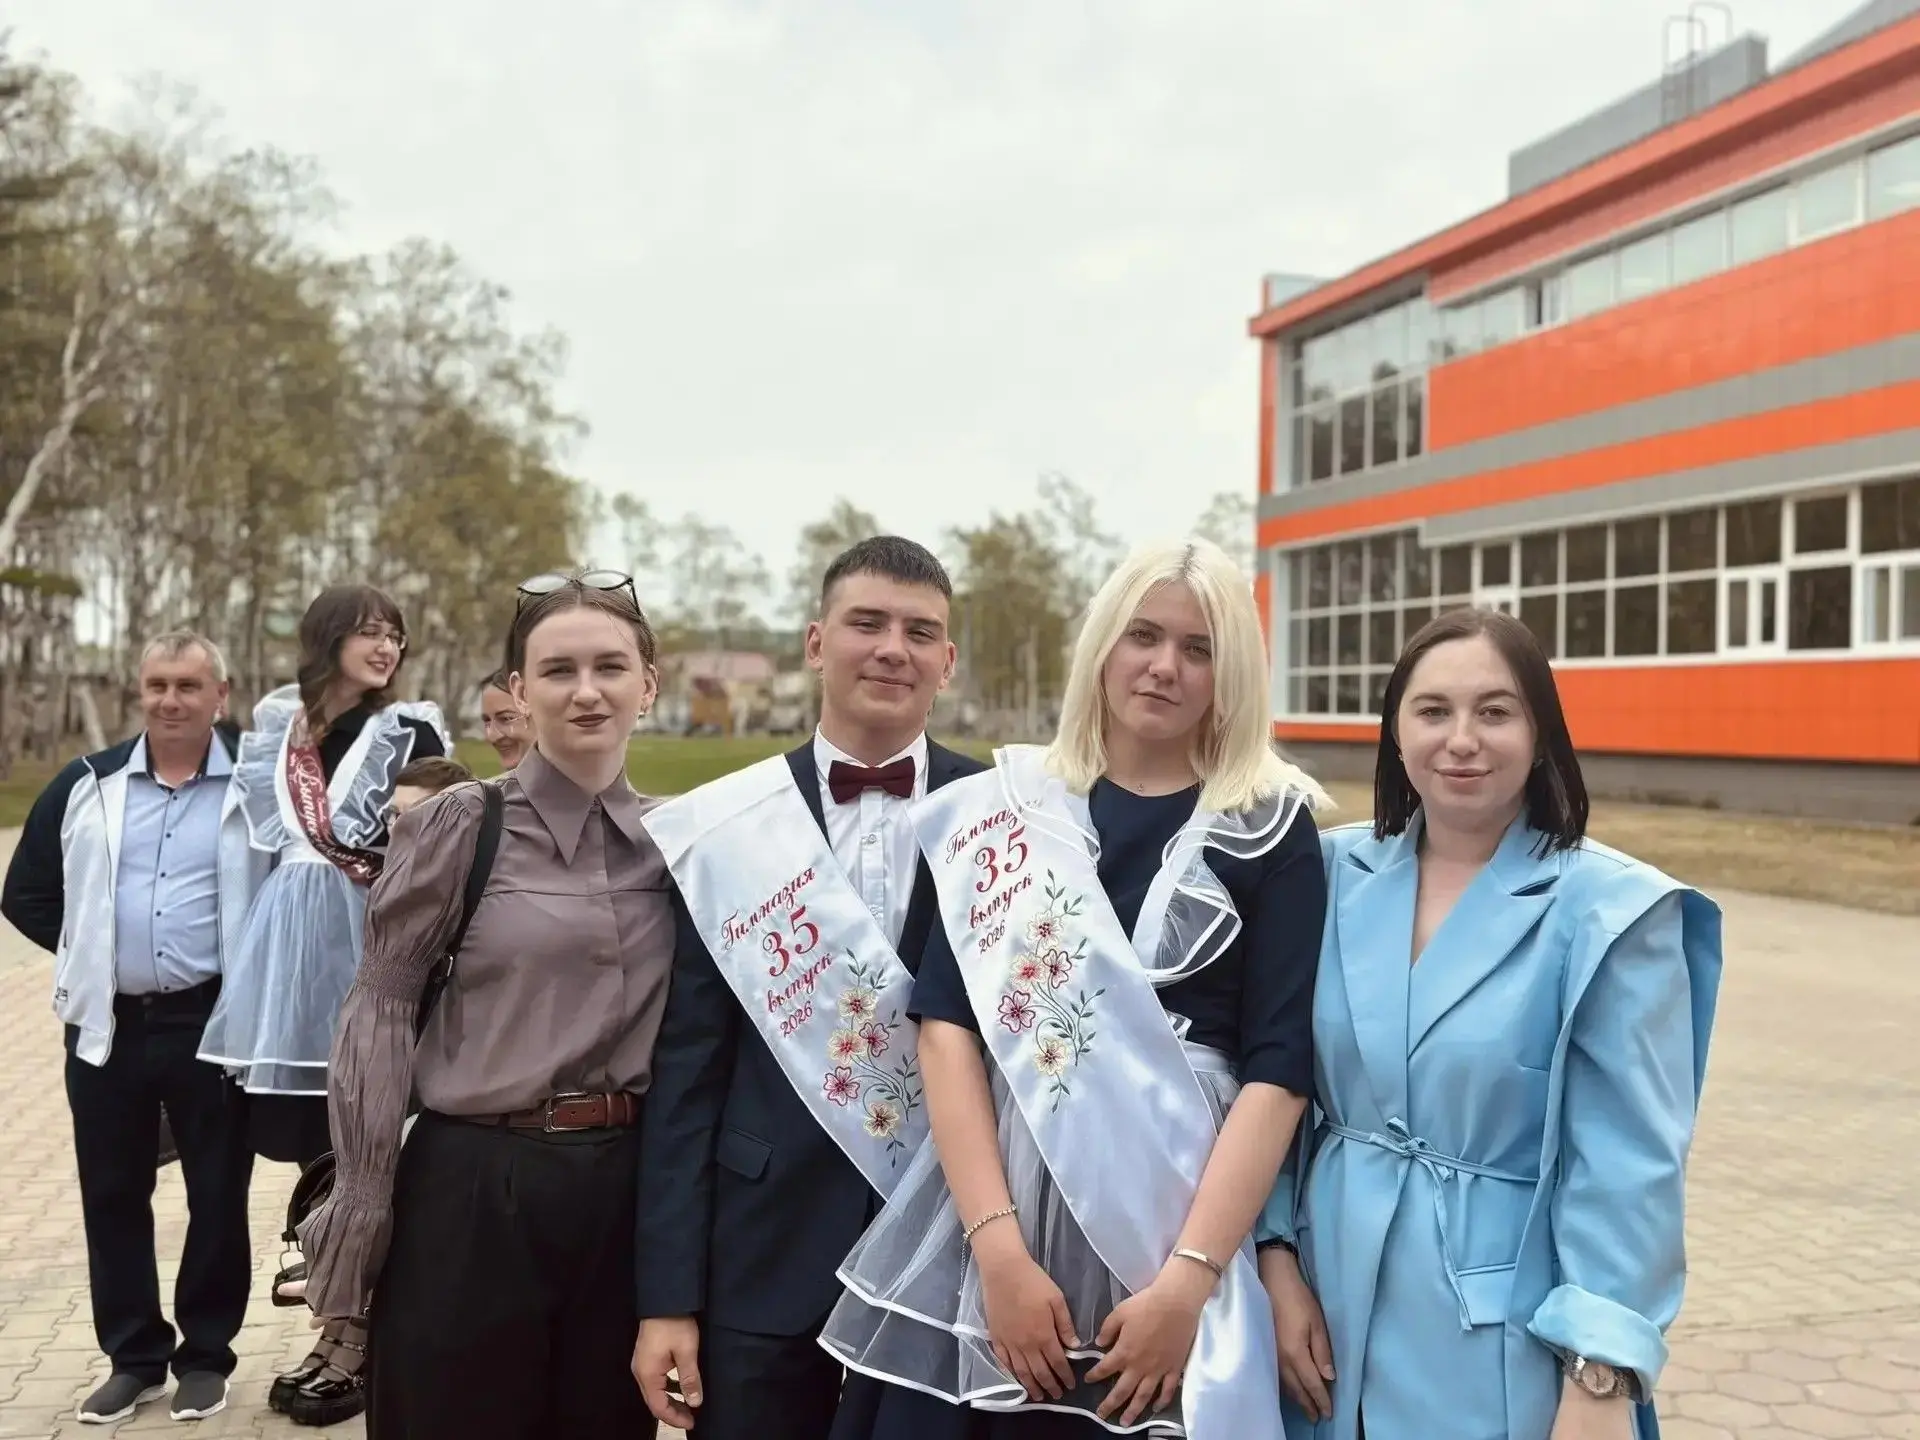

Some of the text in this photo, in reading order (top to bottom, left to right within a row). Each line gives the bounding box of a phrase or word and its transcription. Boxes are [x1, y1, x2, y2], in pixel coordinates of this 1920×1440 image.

[974, 825, 1028, 893] 35
[721, 867, 816, 950] Гимназия
[969, 873, 1033, 929] выпуск
[762, 904, 819, 977] 35
[978, 920, 1006, 954] 2026
[767, 952, 833, 1014] выпуск
[780, 1000, 813, 1038] 2026
